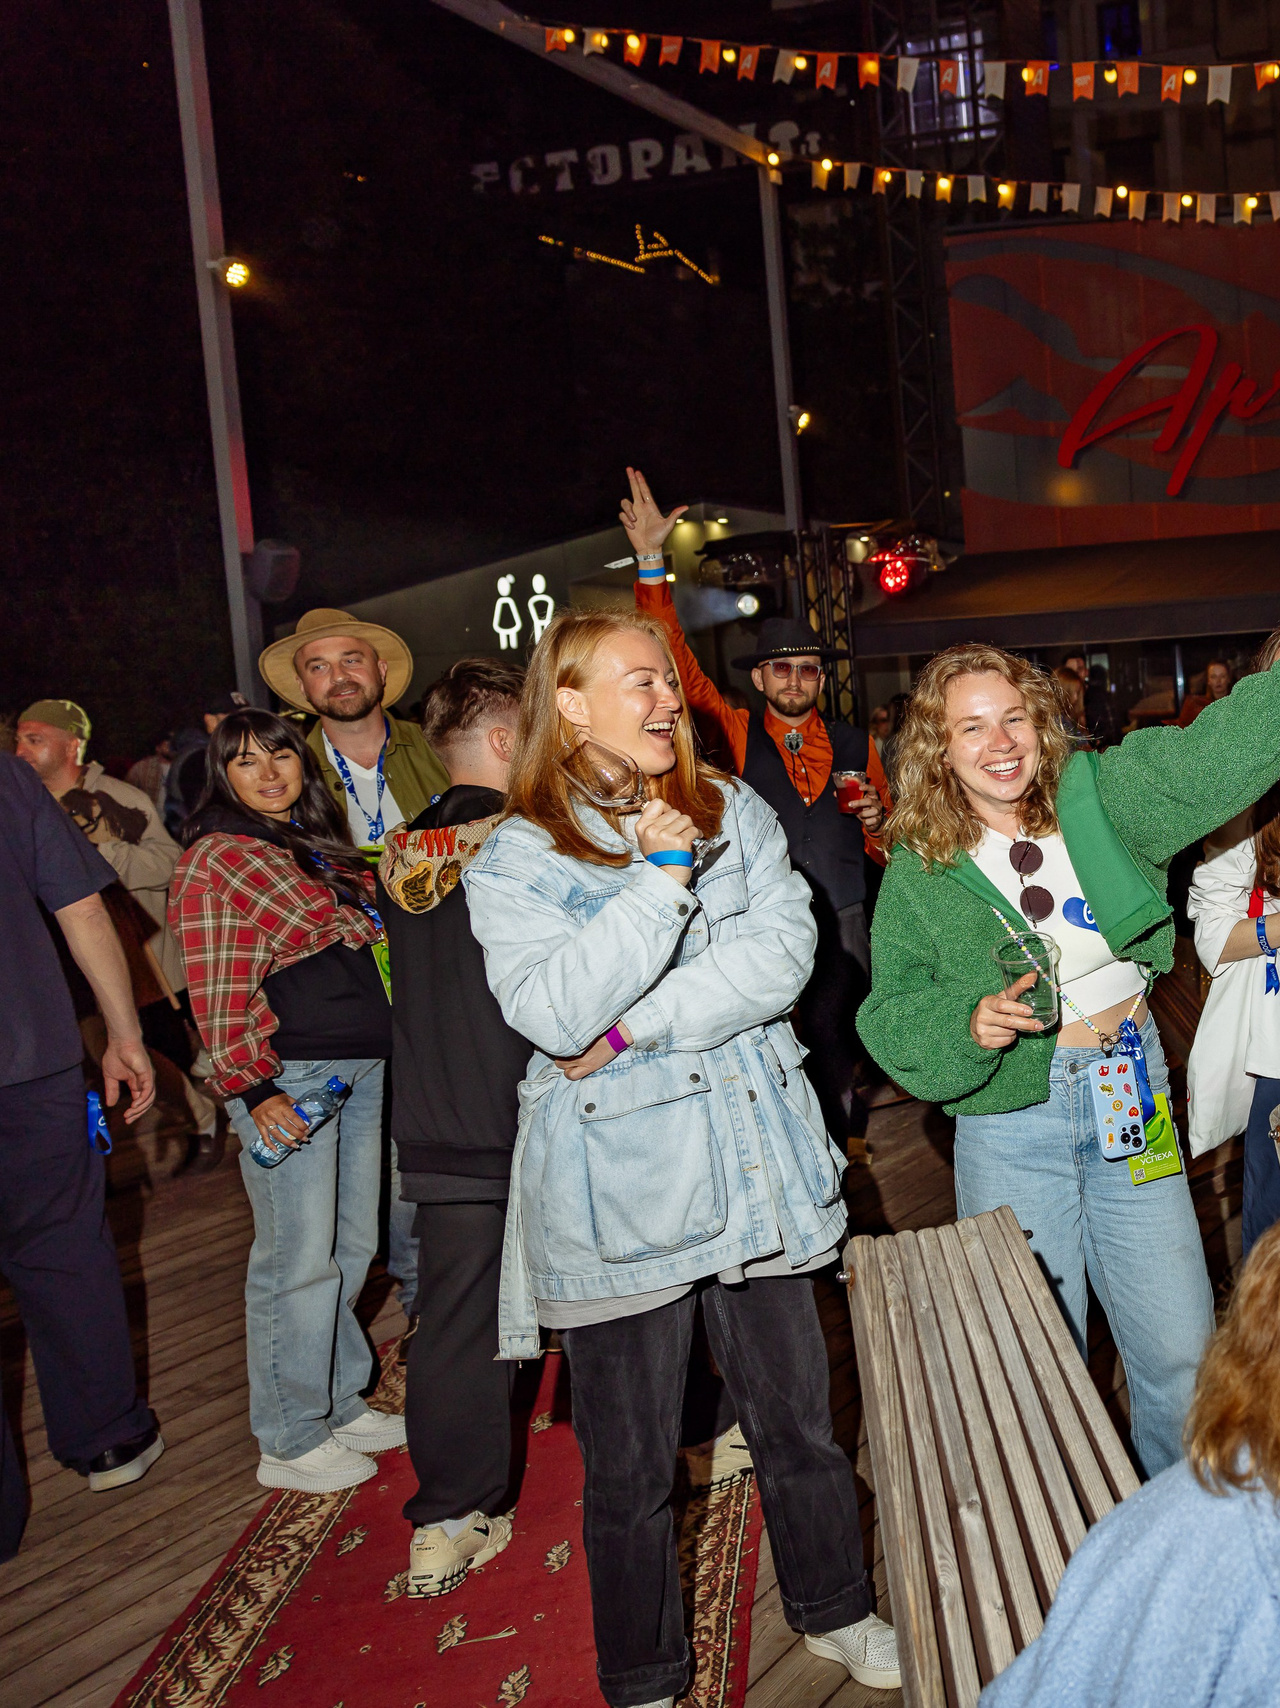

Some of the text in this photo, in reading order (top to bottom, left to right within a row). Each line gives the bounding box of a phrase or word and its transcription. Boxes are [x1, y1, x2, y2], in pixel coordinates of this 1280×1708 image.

[819, 62, 832, 78] A
[1163, 73, 1176, 92] A
[1140, 1150, 1174, 1166] УСПЕХА
